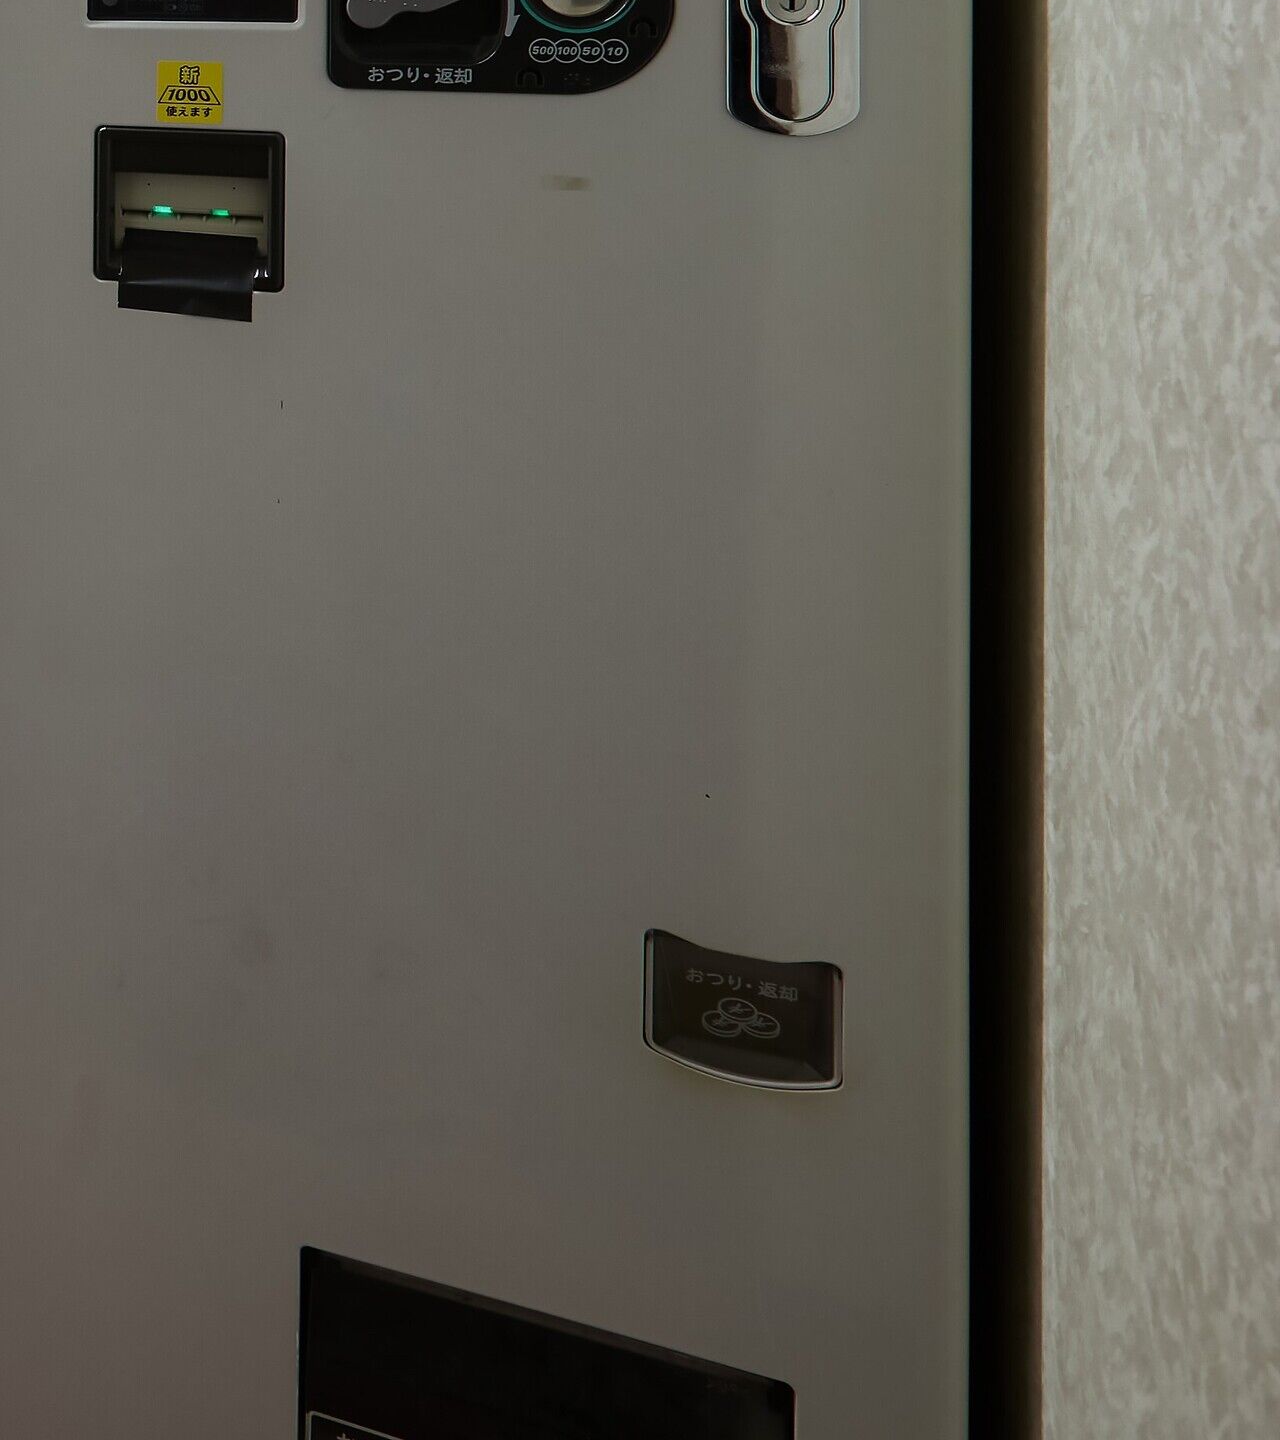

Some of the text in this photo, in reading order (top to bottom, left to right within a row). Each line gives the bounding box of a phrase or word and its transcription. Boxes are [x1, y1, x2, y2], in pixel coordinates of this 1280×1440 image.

[180, 65, 200, 84] 新
[368, 66, 473, 85] おつり・返却
[167, 88, 212, 102] 1000
[166, 105, 213, 118] 使えます
[686, 966, 799, 1003] おつり・返却
